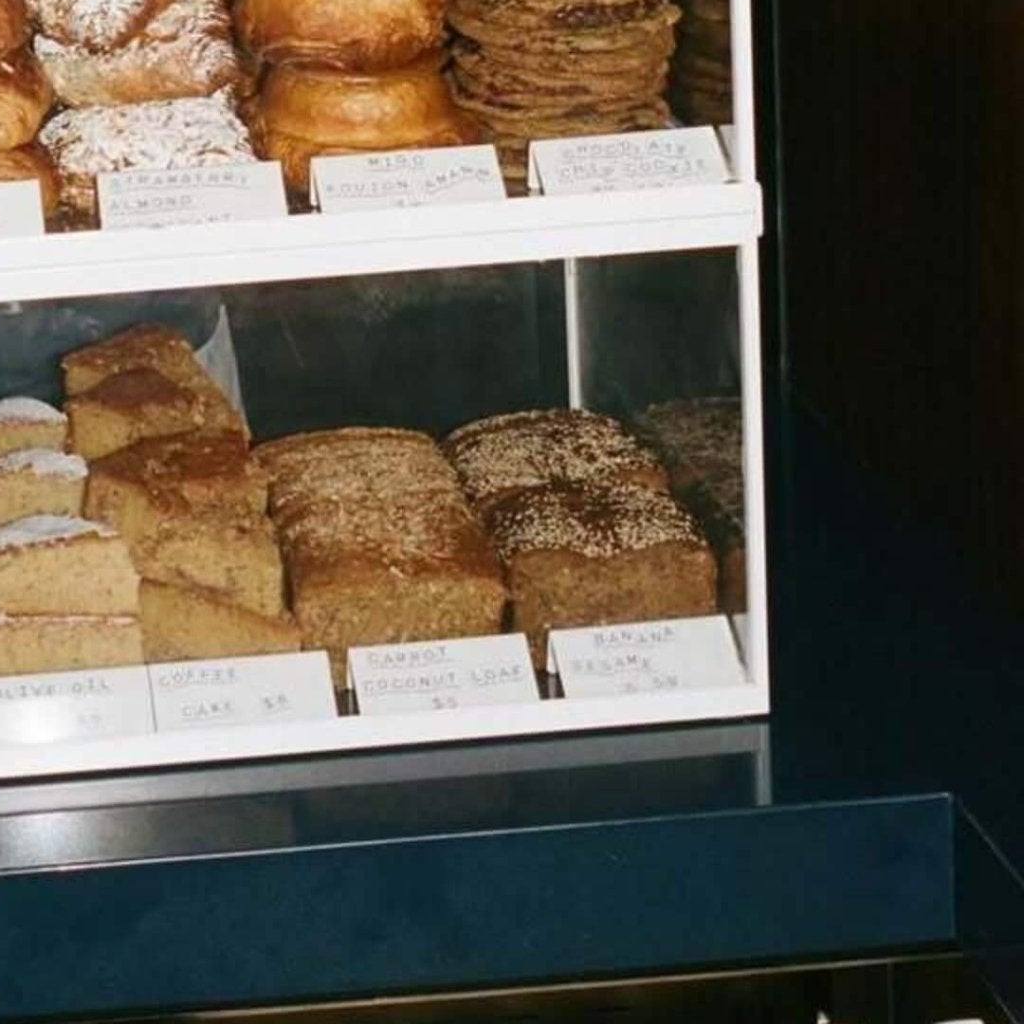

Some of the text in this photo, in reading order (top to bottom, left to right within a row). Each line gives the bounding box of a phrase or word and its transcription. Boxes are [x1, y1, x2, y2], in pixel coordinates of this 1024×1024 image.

[367, 154, 426, 168] MISO
[71, 677, 111, 696] OIL
[363, 670, 457, 693] COCONUT
